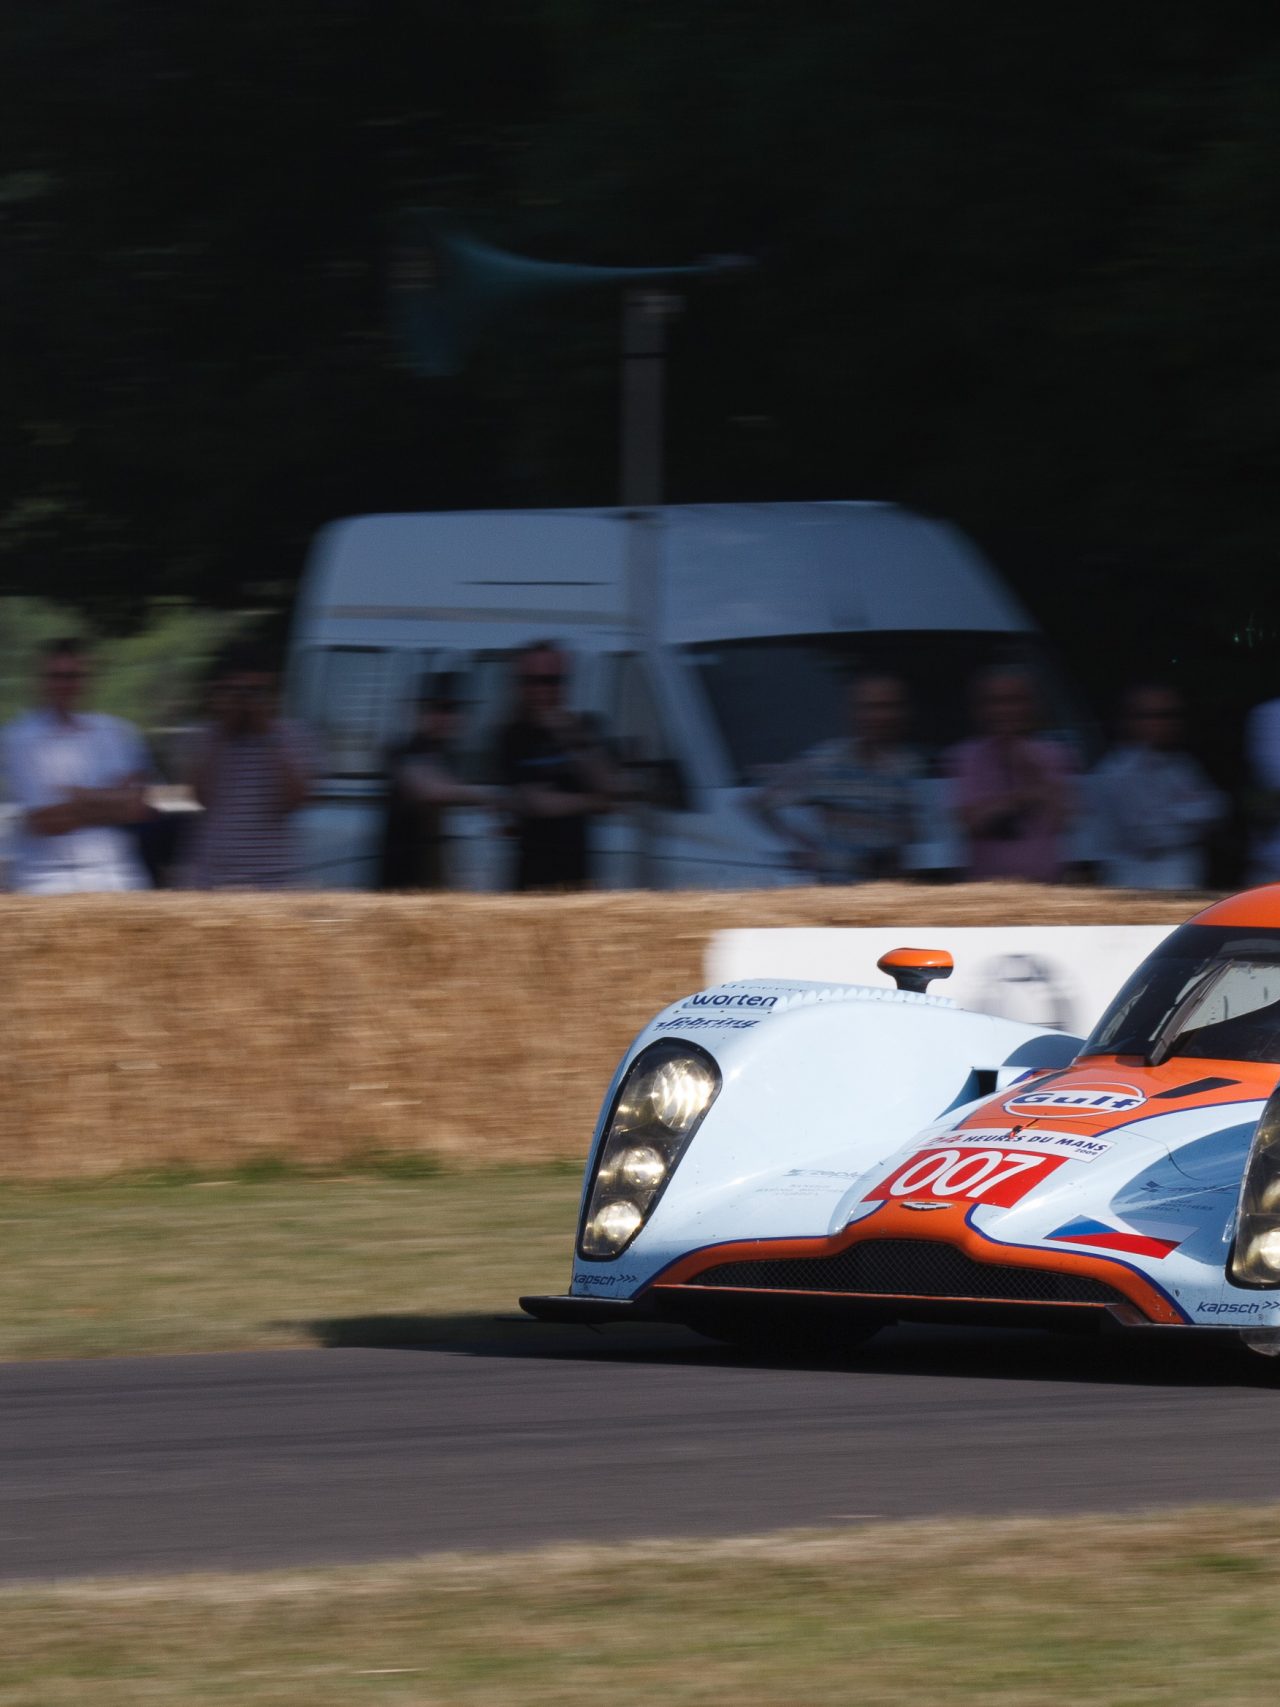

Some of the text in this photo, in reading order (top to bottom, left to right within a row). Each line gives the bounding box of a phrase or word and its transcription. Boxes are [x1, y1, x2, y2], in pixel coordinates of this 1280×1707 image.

[691, 994, 778, 1007] worten
[1011, 1093, 1140, 1109] Gulf
[1027, 1135, 1054, 1143] DU
[1055, 1138, 1108, 1151] MANS
[889, 1149, 1048, 1198] 007
[1196, 1302, 1260, 1314] kapsch
